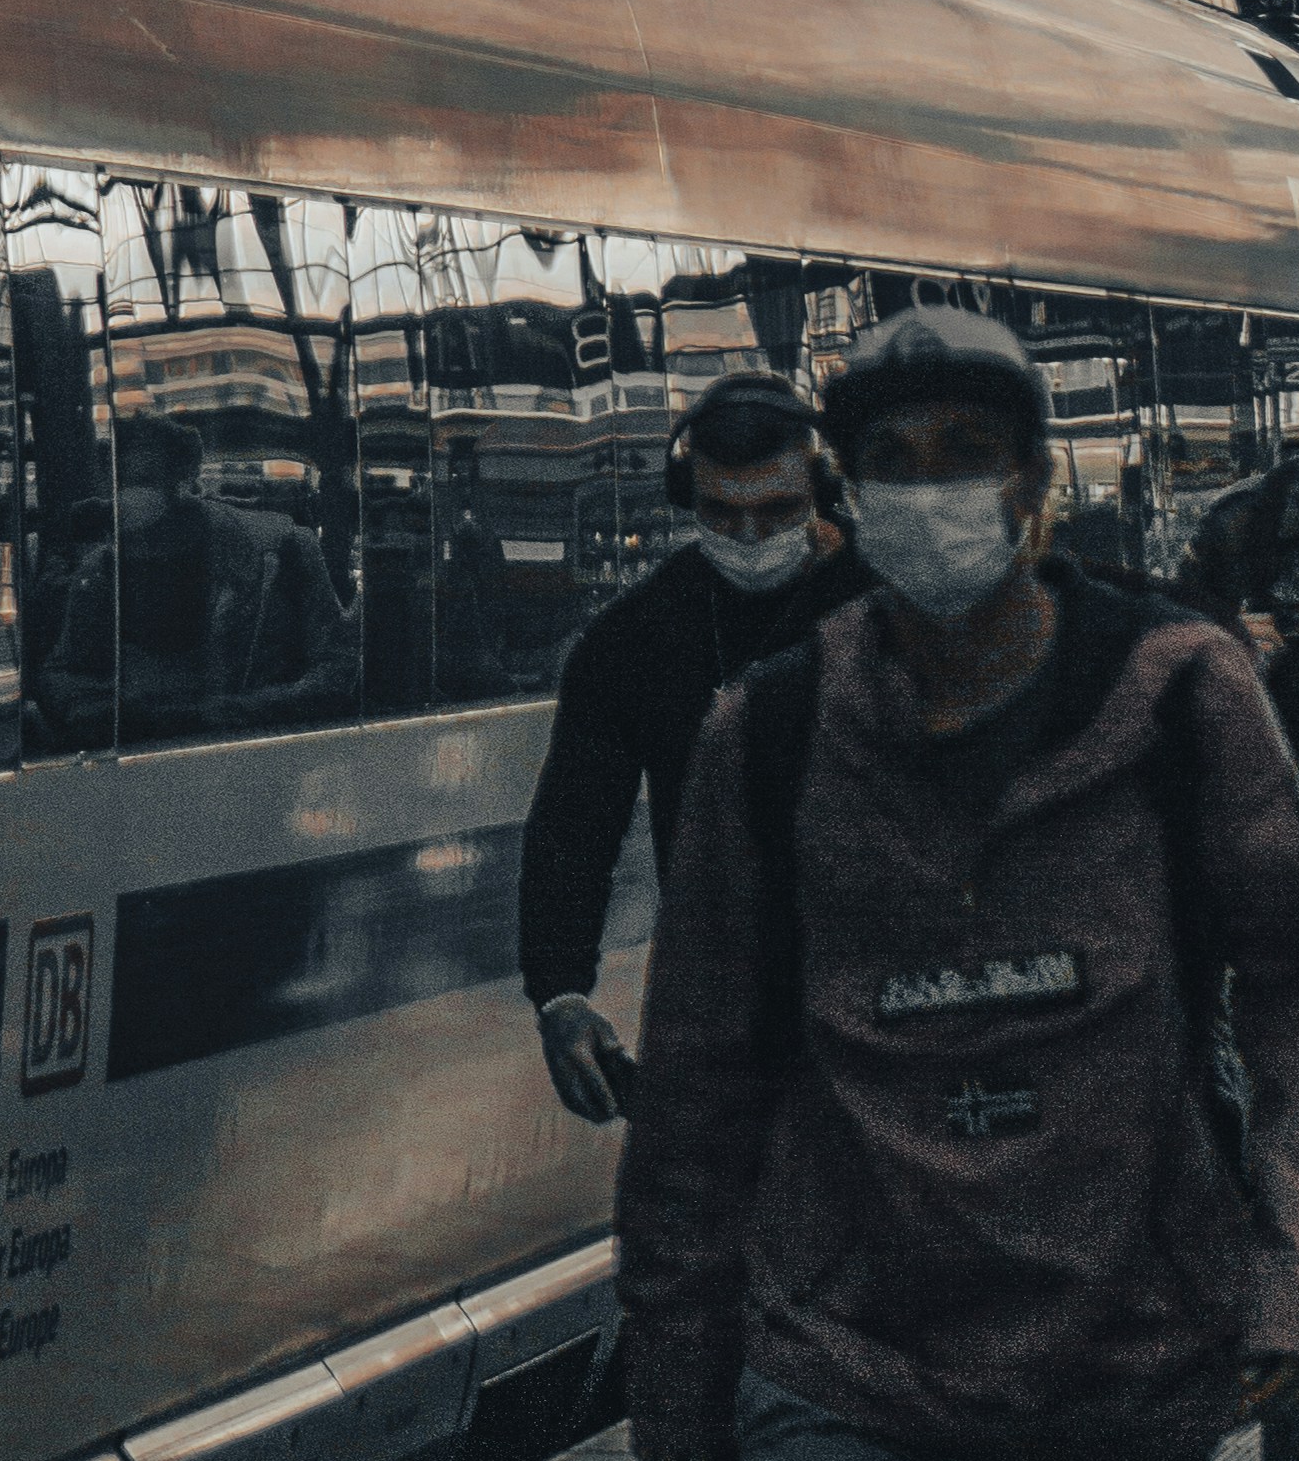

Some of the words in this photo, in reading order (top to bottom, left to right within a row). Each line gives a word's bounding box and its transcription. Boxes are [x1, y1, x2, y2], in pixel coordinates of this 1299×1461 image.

[30, 943, 85, 1069] DB
[6, 1146, 68, 1201] Europa
[7, 1222, 71, 1278] Europa
